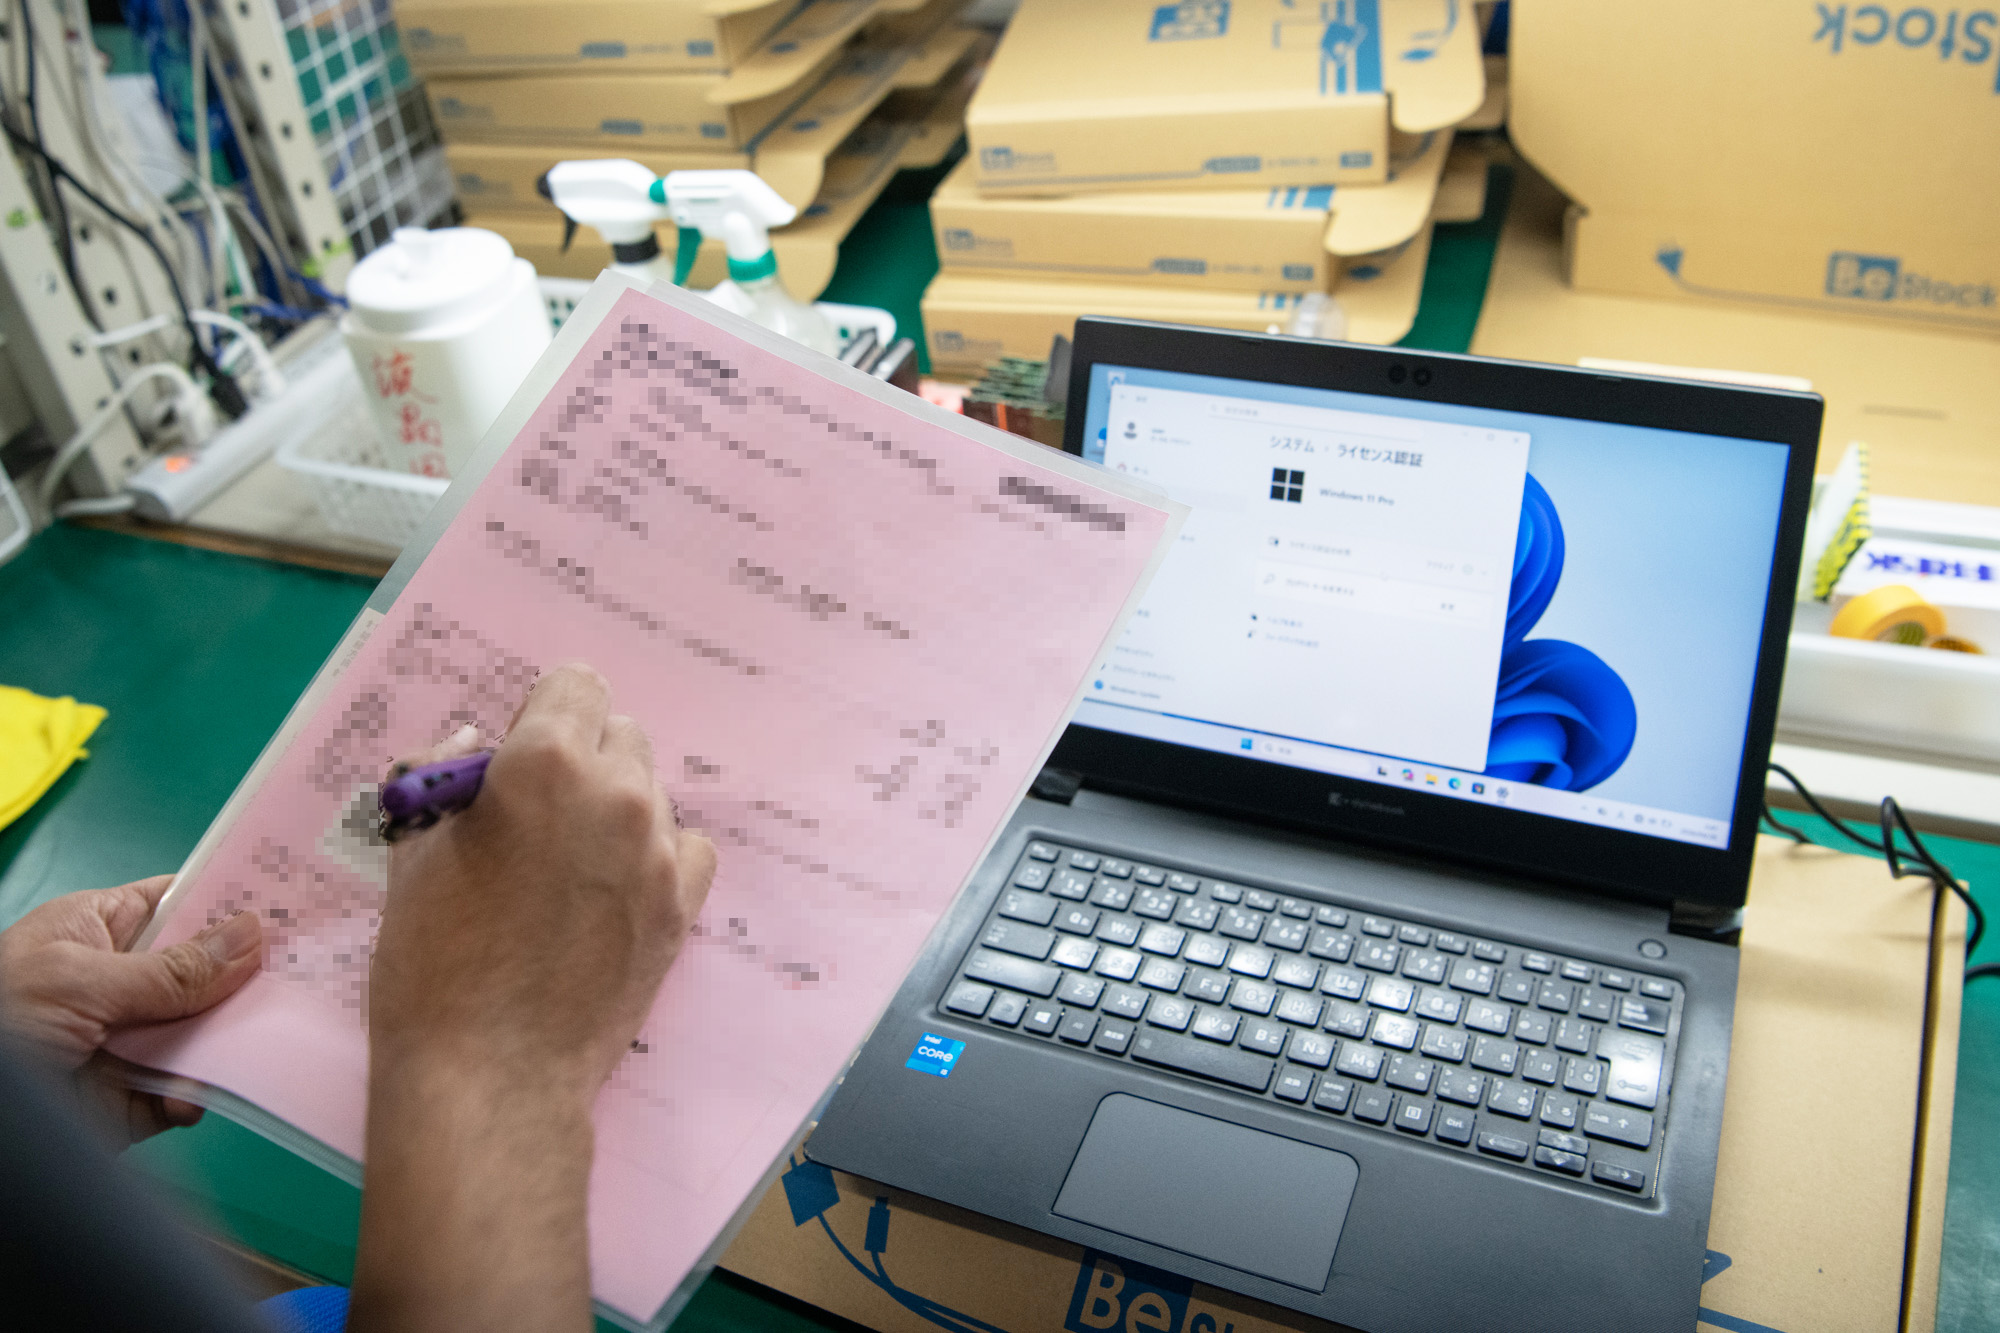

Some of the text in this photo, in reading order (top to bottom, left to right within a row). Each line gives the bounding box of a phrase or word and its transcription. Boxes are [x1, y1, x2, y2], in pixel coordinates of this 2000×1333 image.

[1271, 436, 1423, 467] システム ライセンス認証
[1320, 488, 1395, 506] Windows 11 Pro
[1073, 983, 1086, 996] Z
[1118, 994, 1130, 1007] X
[1210, 1017, 1222, 1029] V
[1254, 1029, 1267, 1041] B
[1302, 1041, 1316, 1054] N
[1350, 1052, 1366, 1066] M
[1446, 1117, 1463, 1129] Ctrl
